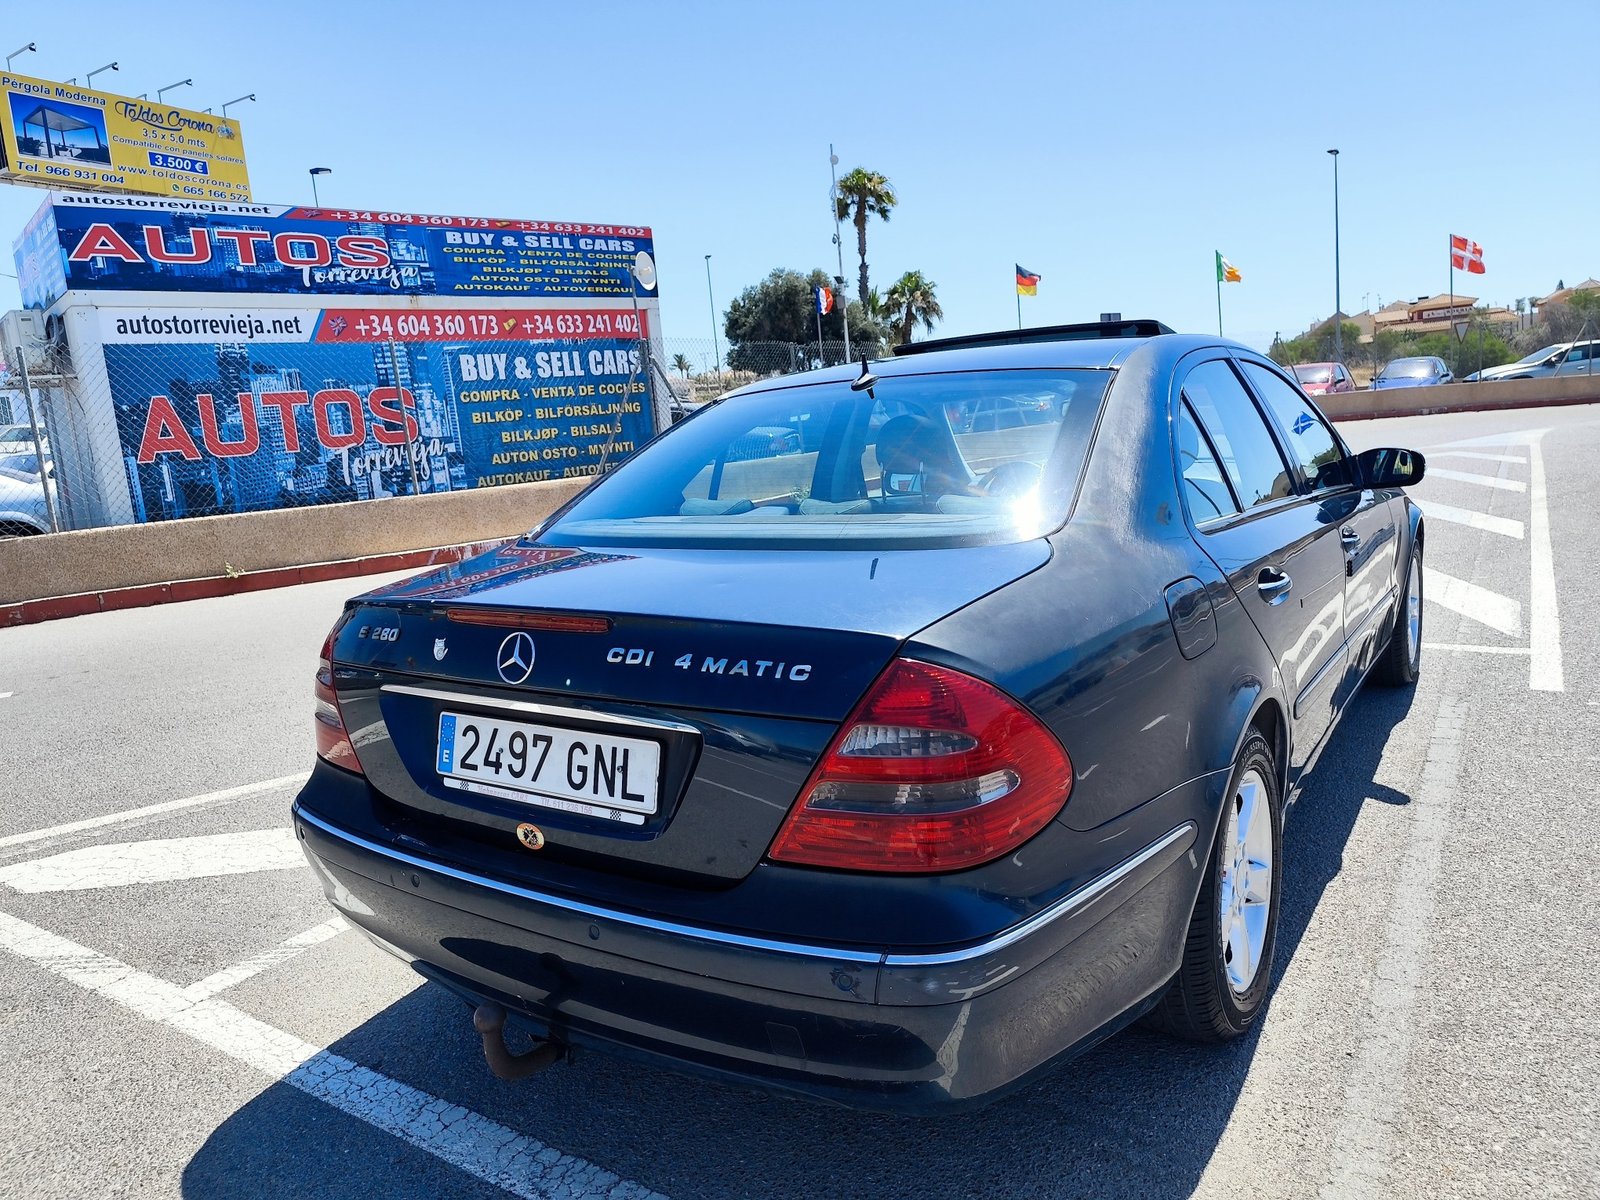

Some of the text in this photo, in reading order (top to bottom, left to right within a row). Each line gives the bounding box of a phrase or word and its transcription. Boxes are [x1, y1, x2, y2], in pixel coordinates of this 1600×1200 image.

[2, 76, 107, 106] Pérgola Moderna
[115, 100, 215, 134] Toldos Corona
[142, 128, 158, 140] 3,5
[170, 132, 185, 145] 5,0
[187, 138, 208, 148] mts.
[112, 134, 245, 165] Compatible con paneles solares
[16, 160, 125, 185] Tel. 966 931 004
[154, 154, 205, 173] 3.500 €
[117, 164, 249, 192] www.toldoscorona.es
[183, 186, 250, 203] 665 166 572
[62, 195, 271, 215] autostorrevieja.net
[331, 211, 646, 236] +34 604 360 173 +34 633 241 402
[68, 222, 389, 269] AUTOS
[445, 231, 636, 252] BUY & SELL CARS
[442, 246, 505, 255] COMPRA
[518, 250, 561, 258] VENTA
[454, 256, 507, 264] BILKÖP
[294, 263, 419, 290] Torrevieja
[483, 266, 542, 274] BILKJØP
[454, 284, 531, 292] AUTOKAUF
[116, 314, 302, 339] autostorrevieja.net
[355, 314, 639, 336] +34 604 360 173 +34 633 241 402
[459, 350, 642, 382] BUY & SELL CARS
[460, 390, 520, 404] COMPRA
[532, 386, 576, 400] VENTA
[579, 384, 596, 396] DE
[136, 386, 419, 464] AUTOS
[472, 408, 524, 424] BILKÖP
[502, 427, 560, 444] BILKJØP
[571, 423, 622, 436] BILSALG
[492, 448, 539, 465] AUTON
[542, 446, 578, 460] OSTO
[478, 469, 551, 488] AUTOKAUF
[358, 625, 400, 642] E 280
[606, 647, 654, 666] CDI
[442, 750, 450, 763] E
[460, 724, 645, 803] 2497 GNL
